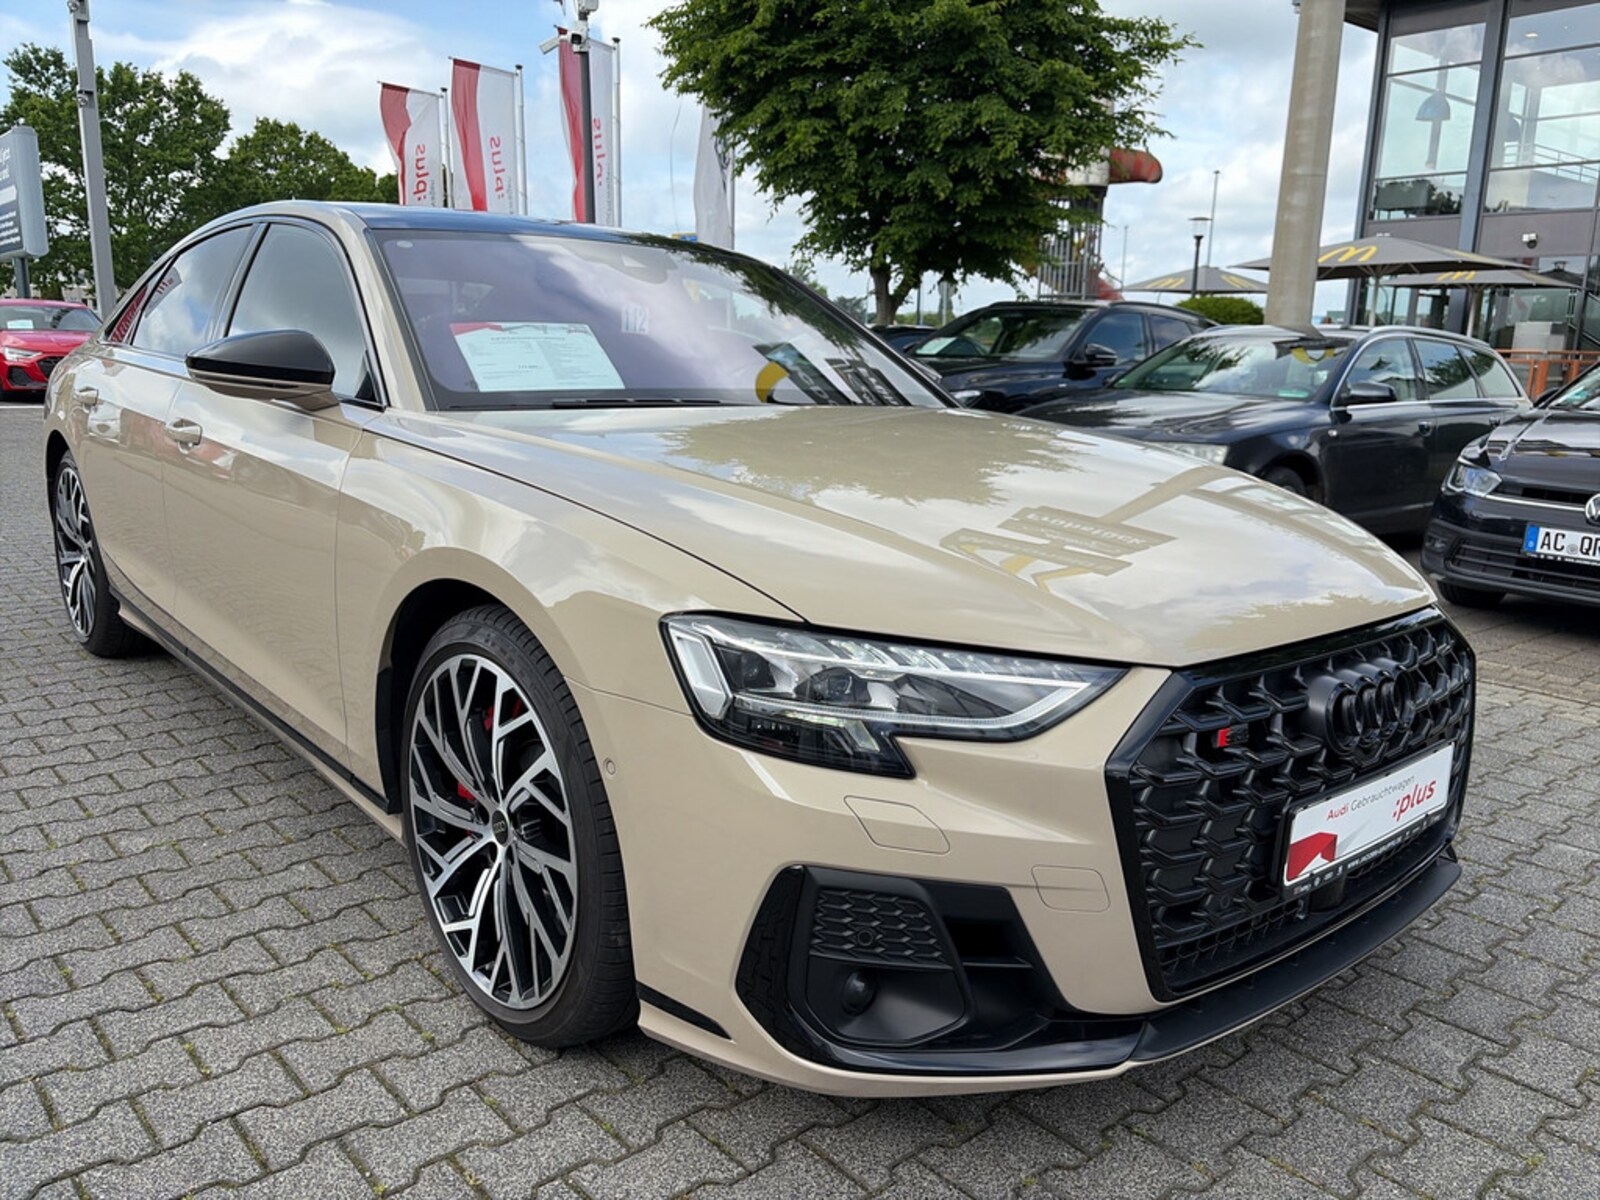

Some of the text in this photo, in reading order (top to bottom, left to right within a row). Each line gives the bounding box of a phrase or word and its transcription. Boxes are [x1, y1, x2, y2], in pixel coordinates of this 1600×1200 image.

[1540, 531, 1566, 551] AC
[1326, 775, 1416, 821] Audi Gebrauchtwagen
[1392, 780, 1437, 822] :plus
